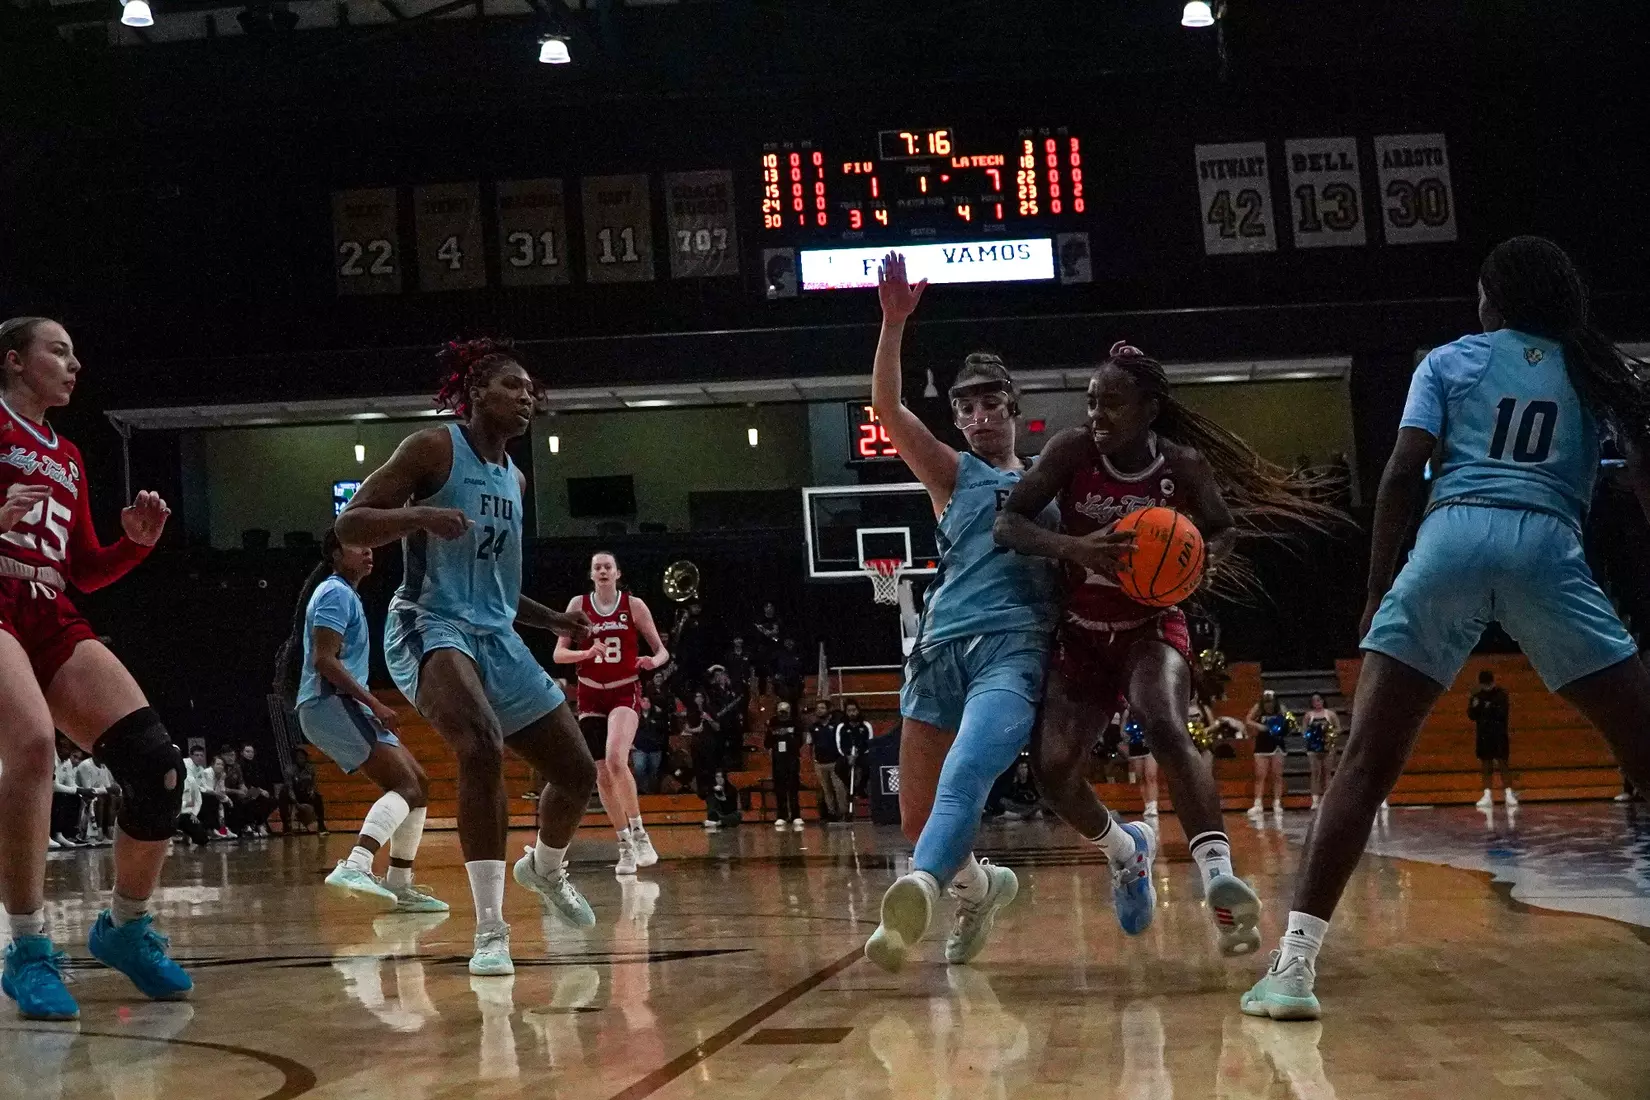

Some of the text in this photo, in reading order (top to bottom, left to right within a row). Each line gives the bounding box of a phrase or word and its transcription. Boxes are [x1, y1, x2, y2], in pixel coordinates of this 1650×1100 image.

[899, 130, 950, 155] 7:16
[1024, 137, 1080, 154] 3 0 3
[763, 151, 822, 168] 10 0 0
[843, 162, 873, 174] FIU
[1020, 152, 1080, 169] 18 0 0
[1200, 156, 1265, 180] STEWART
[1292, 152, 1354, 173] BELL
[1383, 148, 1444, 169] ARROYO
[764, 168, 779, 183] 13
[792, 167, 802, 182] 0
[920, 176, 926, 193] 1
[985, 169, 1000, 191] 7
[1017, 168, 1082, 184] 22 0 0
[765, 182, 825, 198] 15 0 0
[872, 176, 878, 198] 1
[1018, 184, 1037, 200] 23
[1050, 184, 1060, 198] 0
[1074, 182, 1083, 197] 2
[762, 199, 781, 213] 24
[794, 198, 804, 212] 0
[816, 196, 826, 210] 0
[957, 202, 1003, 222] 4 1
[1020, 198, 1084, 215] 25 0 0
[1295, 183, 1359, 233] 13
[1386, 177, 1449, 228] 30
[764, 212, 827, 229] 30 1 0
[849, 208, 888, 229] 3 4
[1208, 189, 1266, 239] 42
[438, 236, 463, 270] 4
[508, 231, 558, 266] 31
[598, 226, 639, 264] 11
[942, 244, 1030, 264] VAMOS
[340, 239, 394, 276] 22
[1488, 397, 1559, 463] 10
[480, 493, 513, 520] FIU
[476, 525, 509, 562] 24
